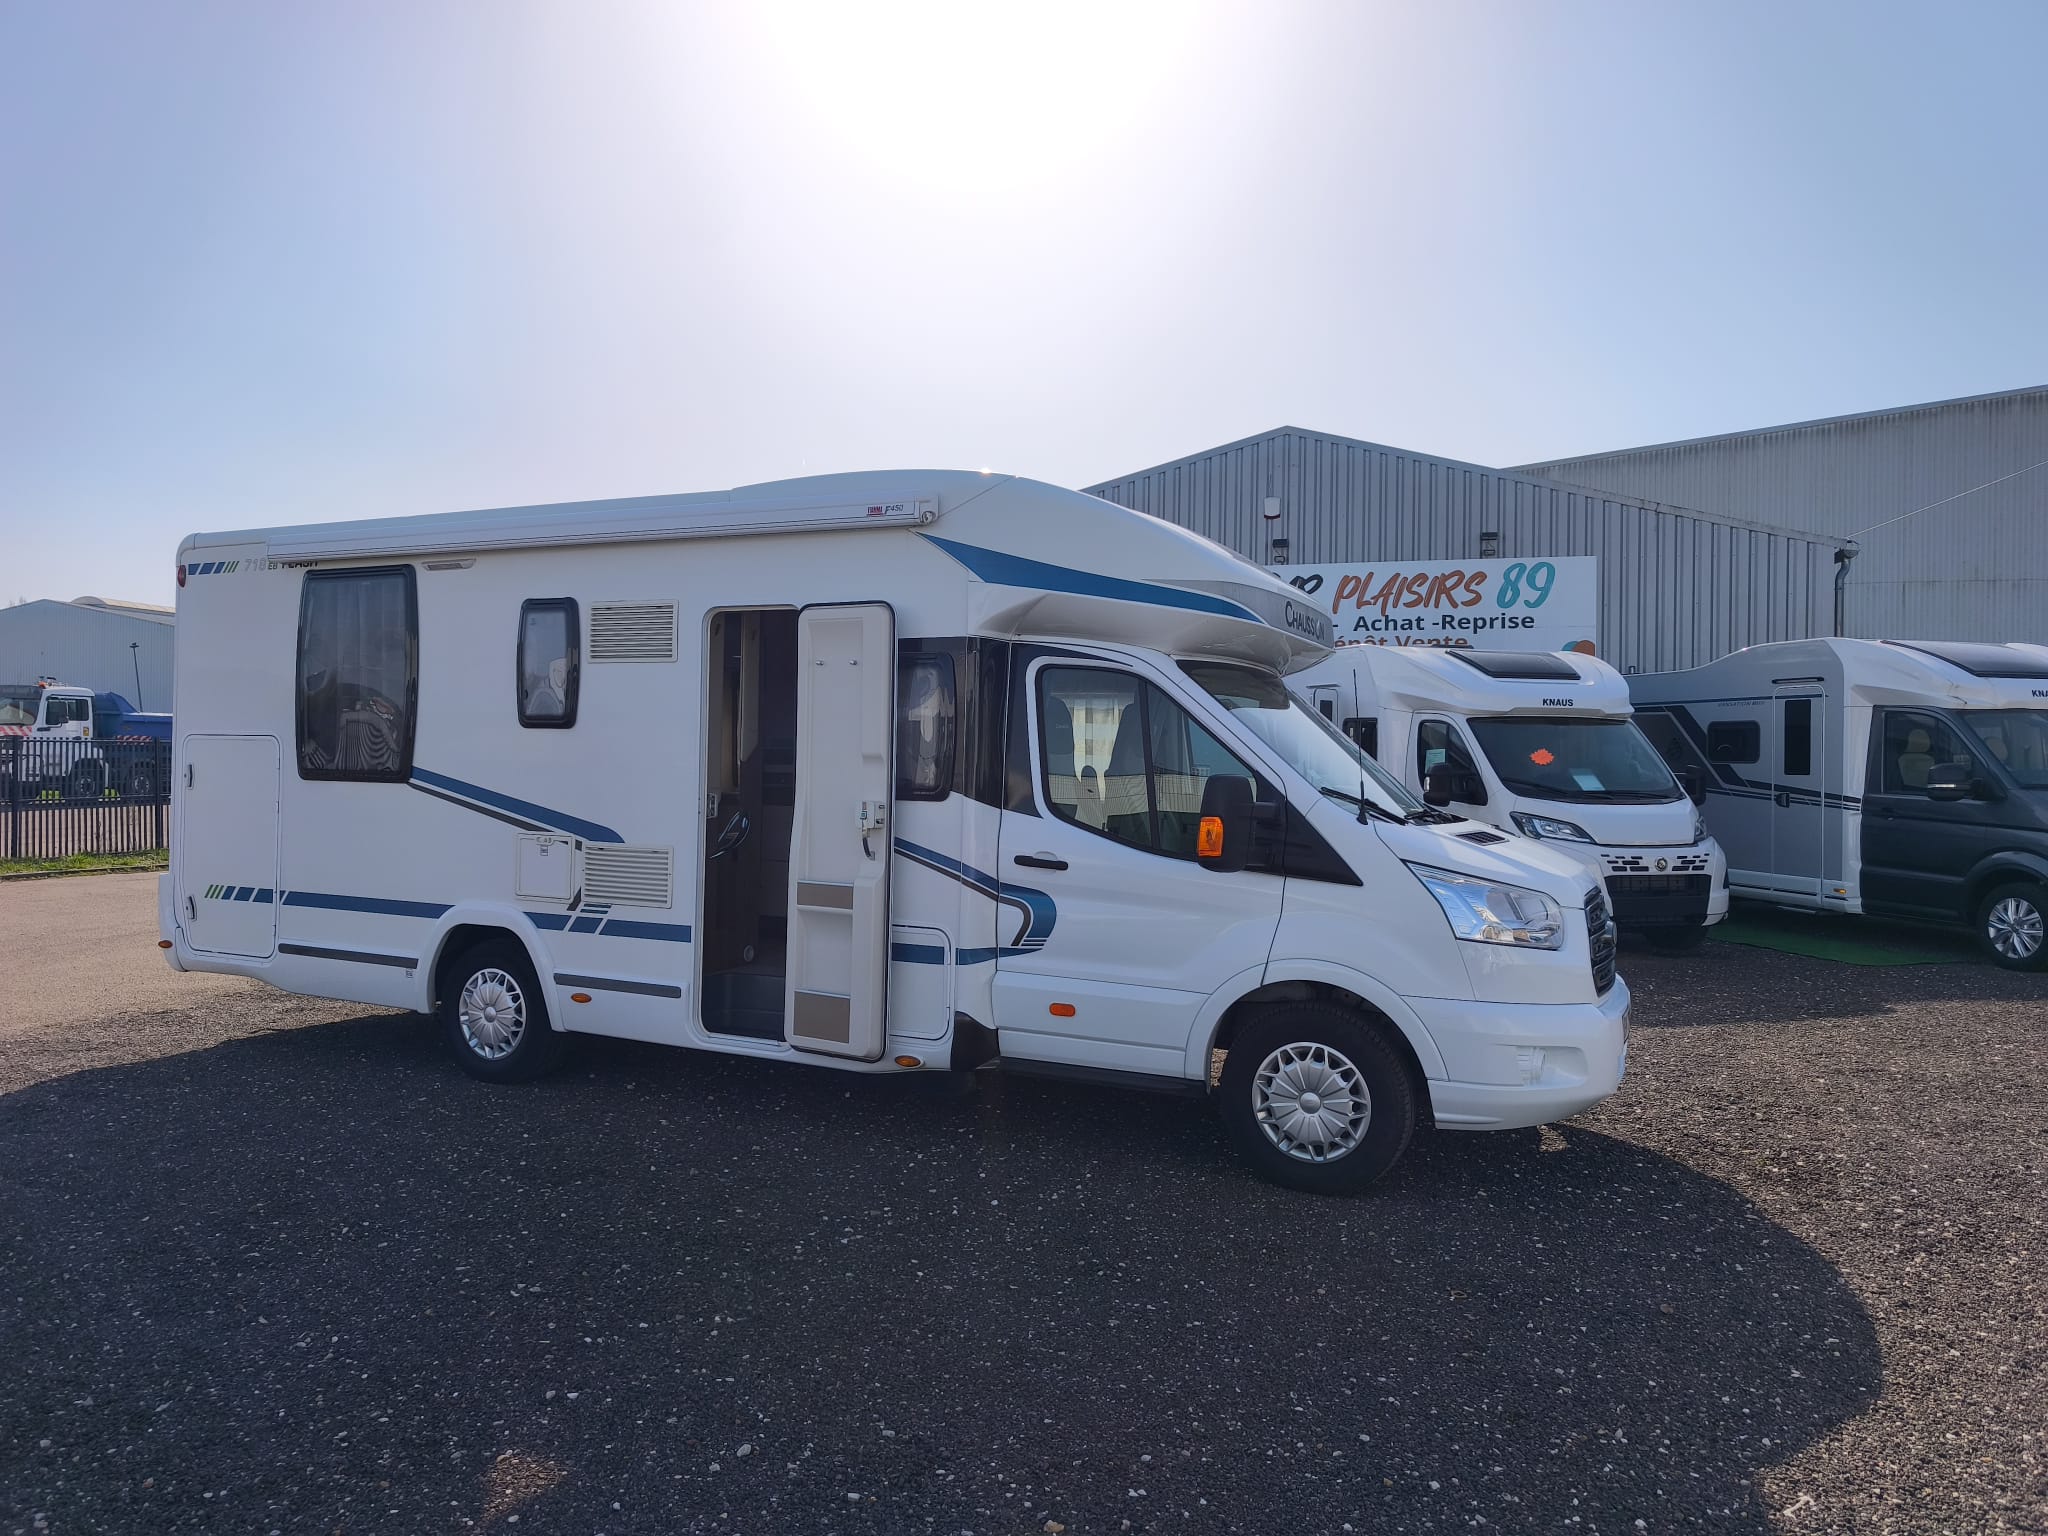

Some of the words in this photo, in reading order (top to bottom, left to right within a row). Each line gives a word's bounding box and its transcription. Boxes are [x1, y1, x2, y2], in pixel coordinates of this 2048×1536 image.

[1332, 570, 1487, 617] PLAISIRS
[1496, 562, 1556, 609] 89
[1353, 615, 1425, 632] Achat
[1542, 698, 1574, 707] KNAUS
